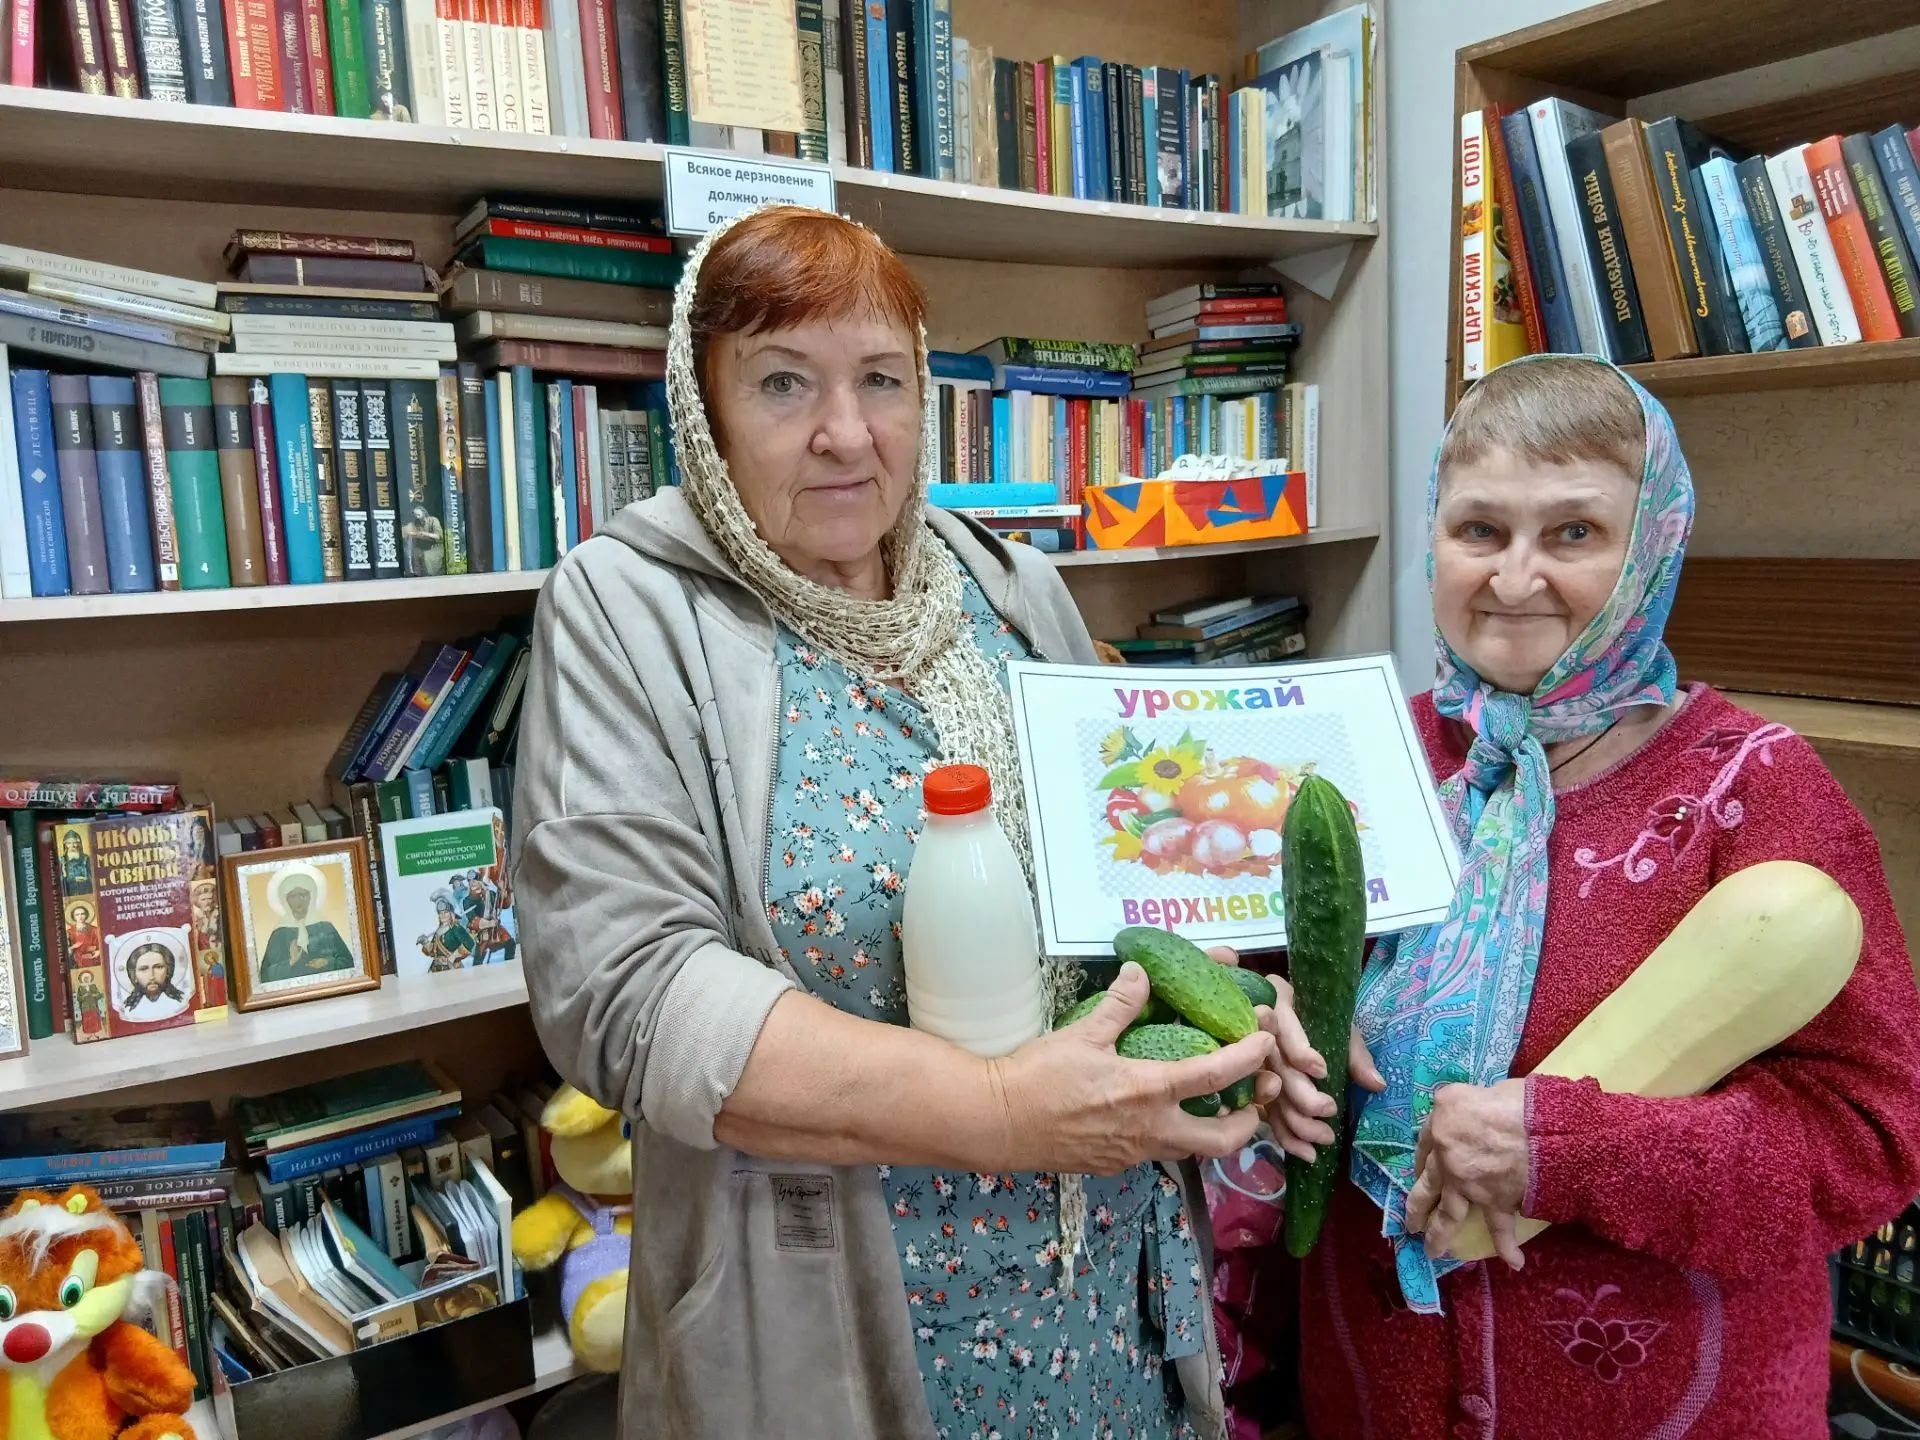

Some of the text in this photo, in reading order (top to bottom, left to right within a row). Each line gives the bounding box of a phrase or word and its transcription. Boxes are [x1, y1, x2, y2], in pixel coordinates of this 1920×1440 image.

[895, 31, 913, 170] ПОСЛЕДНЯЯ ВОЙНА
[935, 20, 949, 156] БОГОРОДИЦА
[475, 92, 491, 130] ВЕС
[687, 162, 814, 188] Всякое дерзновение
[1662, 150, 1688, 214] Христофор
[708, 190, 758, 204] должно
[1583, 169, 1609, 224] ВОЙНА
[1463, 135, 1481, 344] ЦАРСКИЙ СТОЛ
[1598, 210, 1631, 323] ПОСЛЕДНЯЯ
[27, 389, 42, 457] ЛЕСТВИЦА
[150, 448, 174, 561] АПЕЛЬСИНОВЫЕ СВЯТЫЕ
[448, 474, 462, 563] ПУСТЬ ГОВОРИТ БОГ
[87, 565, 94, 576] 1
[129, 564, 137, 576] 2
[200, 562, 209, 574] 4
[244, 559, 252, 570] 5
[1113, 677, 1304, 718] урожай
[373, 727, 405, 766] ПОМОГИ
[6, 788, 163, 805] ЦВЕТЫ У ВАШЕГО
[96, 826, 178, 849] ИКОНЫ
[406, 849, 434, 860] СВЯТОЙ
[457, 843, 486, 853] РОССИИ
[97, 848, 178, 870] МОЛИТВЫ
[443, 853, 476, 863] РУССКИЙ
[100, 880, 186, 897] КОТОРЫЕ ИСЦЕЛЯЮТ
[123, 890, 172, 902] ПОМОГАЮТ
[117, 904, 122, 912] В
[146, 906, 174, 918] НУЖДЕ
[1123, 876, 1390, 932] верхневоя
[25, 847, 45, 1002] Старецъ Зосима Верховскій
[290, 1130, 417, 1172] МОЛИТВЫ МАТЕРИ
[145, 1176, 216, 1192] ЖЕНСКОЕ
[276, 1196, 286, 1230] ТЮШКА
